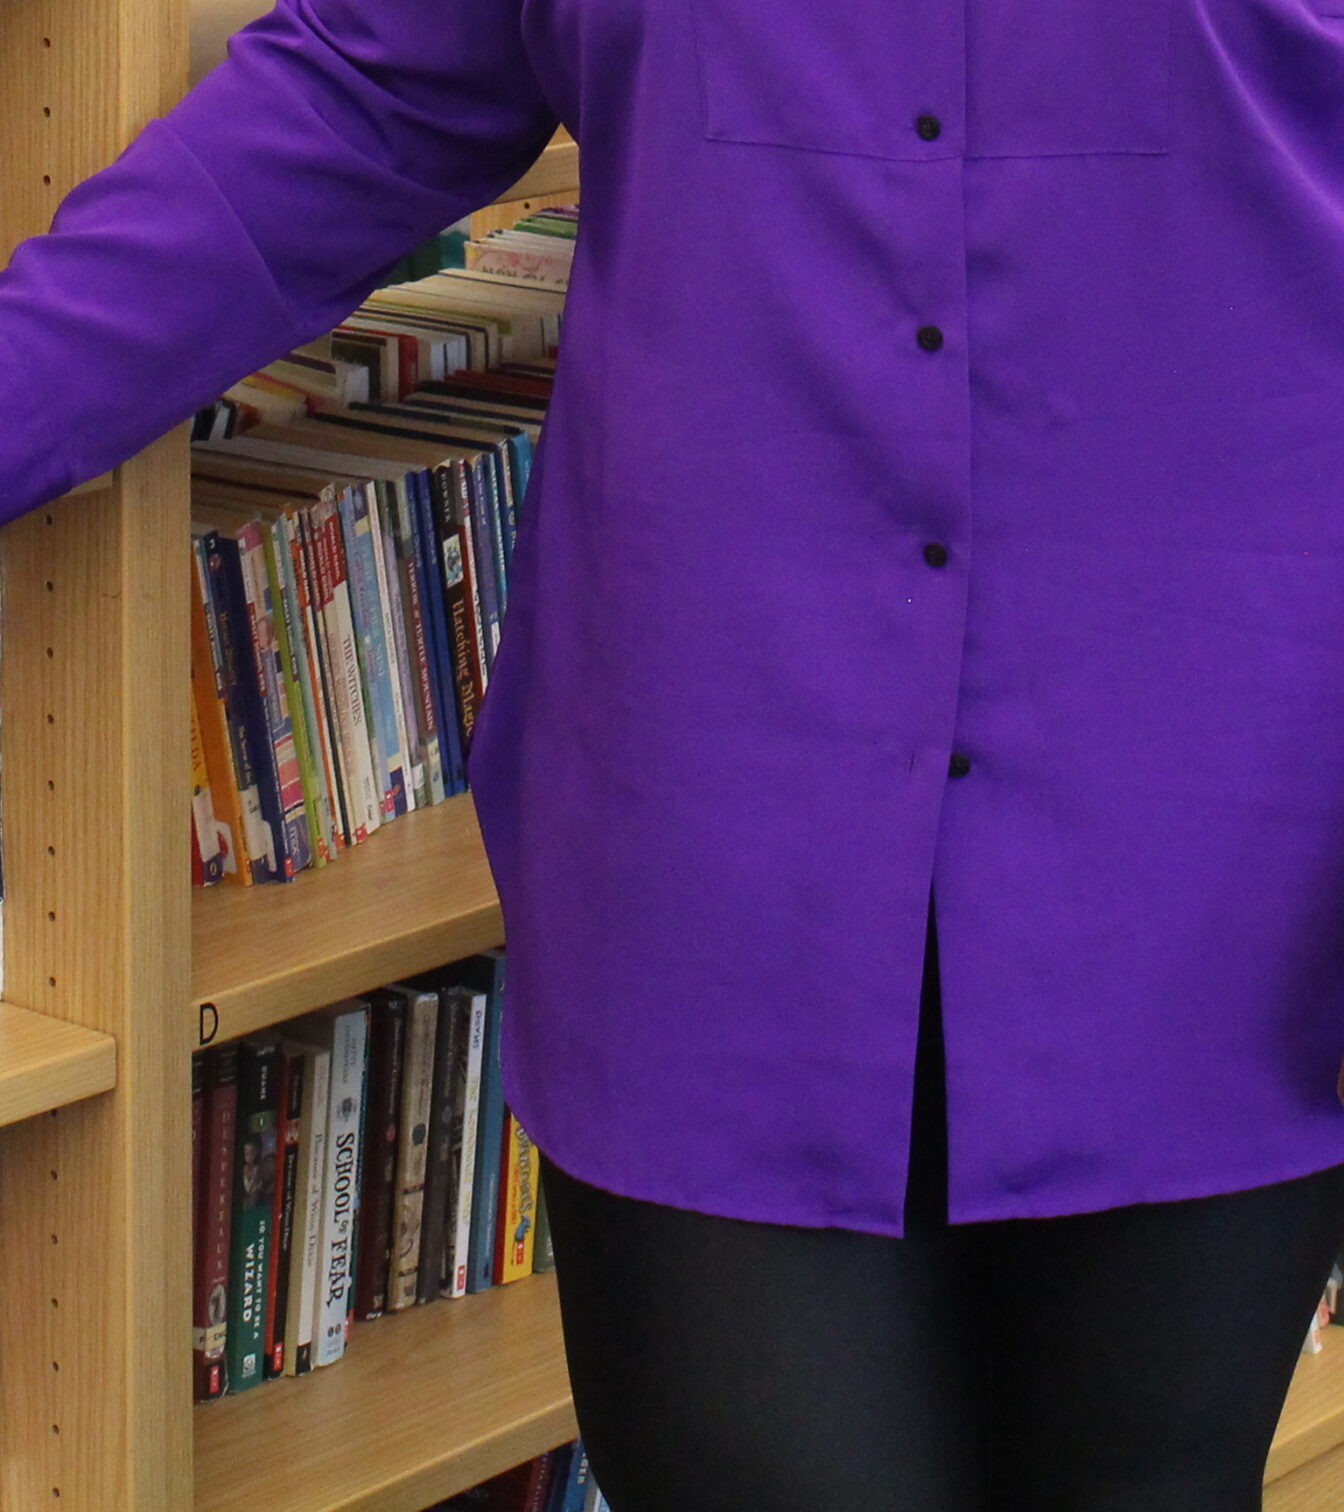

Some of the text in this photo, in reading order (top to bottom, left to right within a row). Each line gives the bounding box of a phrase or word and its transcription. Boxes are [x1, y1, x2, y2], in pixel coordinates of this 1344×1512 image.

[452, 599, 470, 680] Hatching
[343, 637, 363, 727] THE WITCHES
[199, 1003, 219, 1045] D
[332, 1131, 357, 1224] SCHOOL
[240, 1242, 258, 1324] WIZARD
[324, 1237, 357, 1309] FEAR
